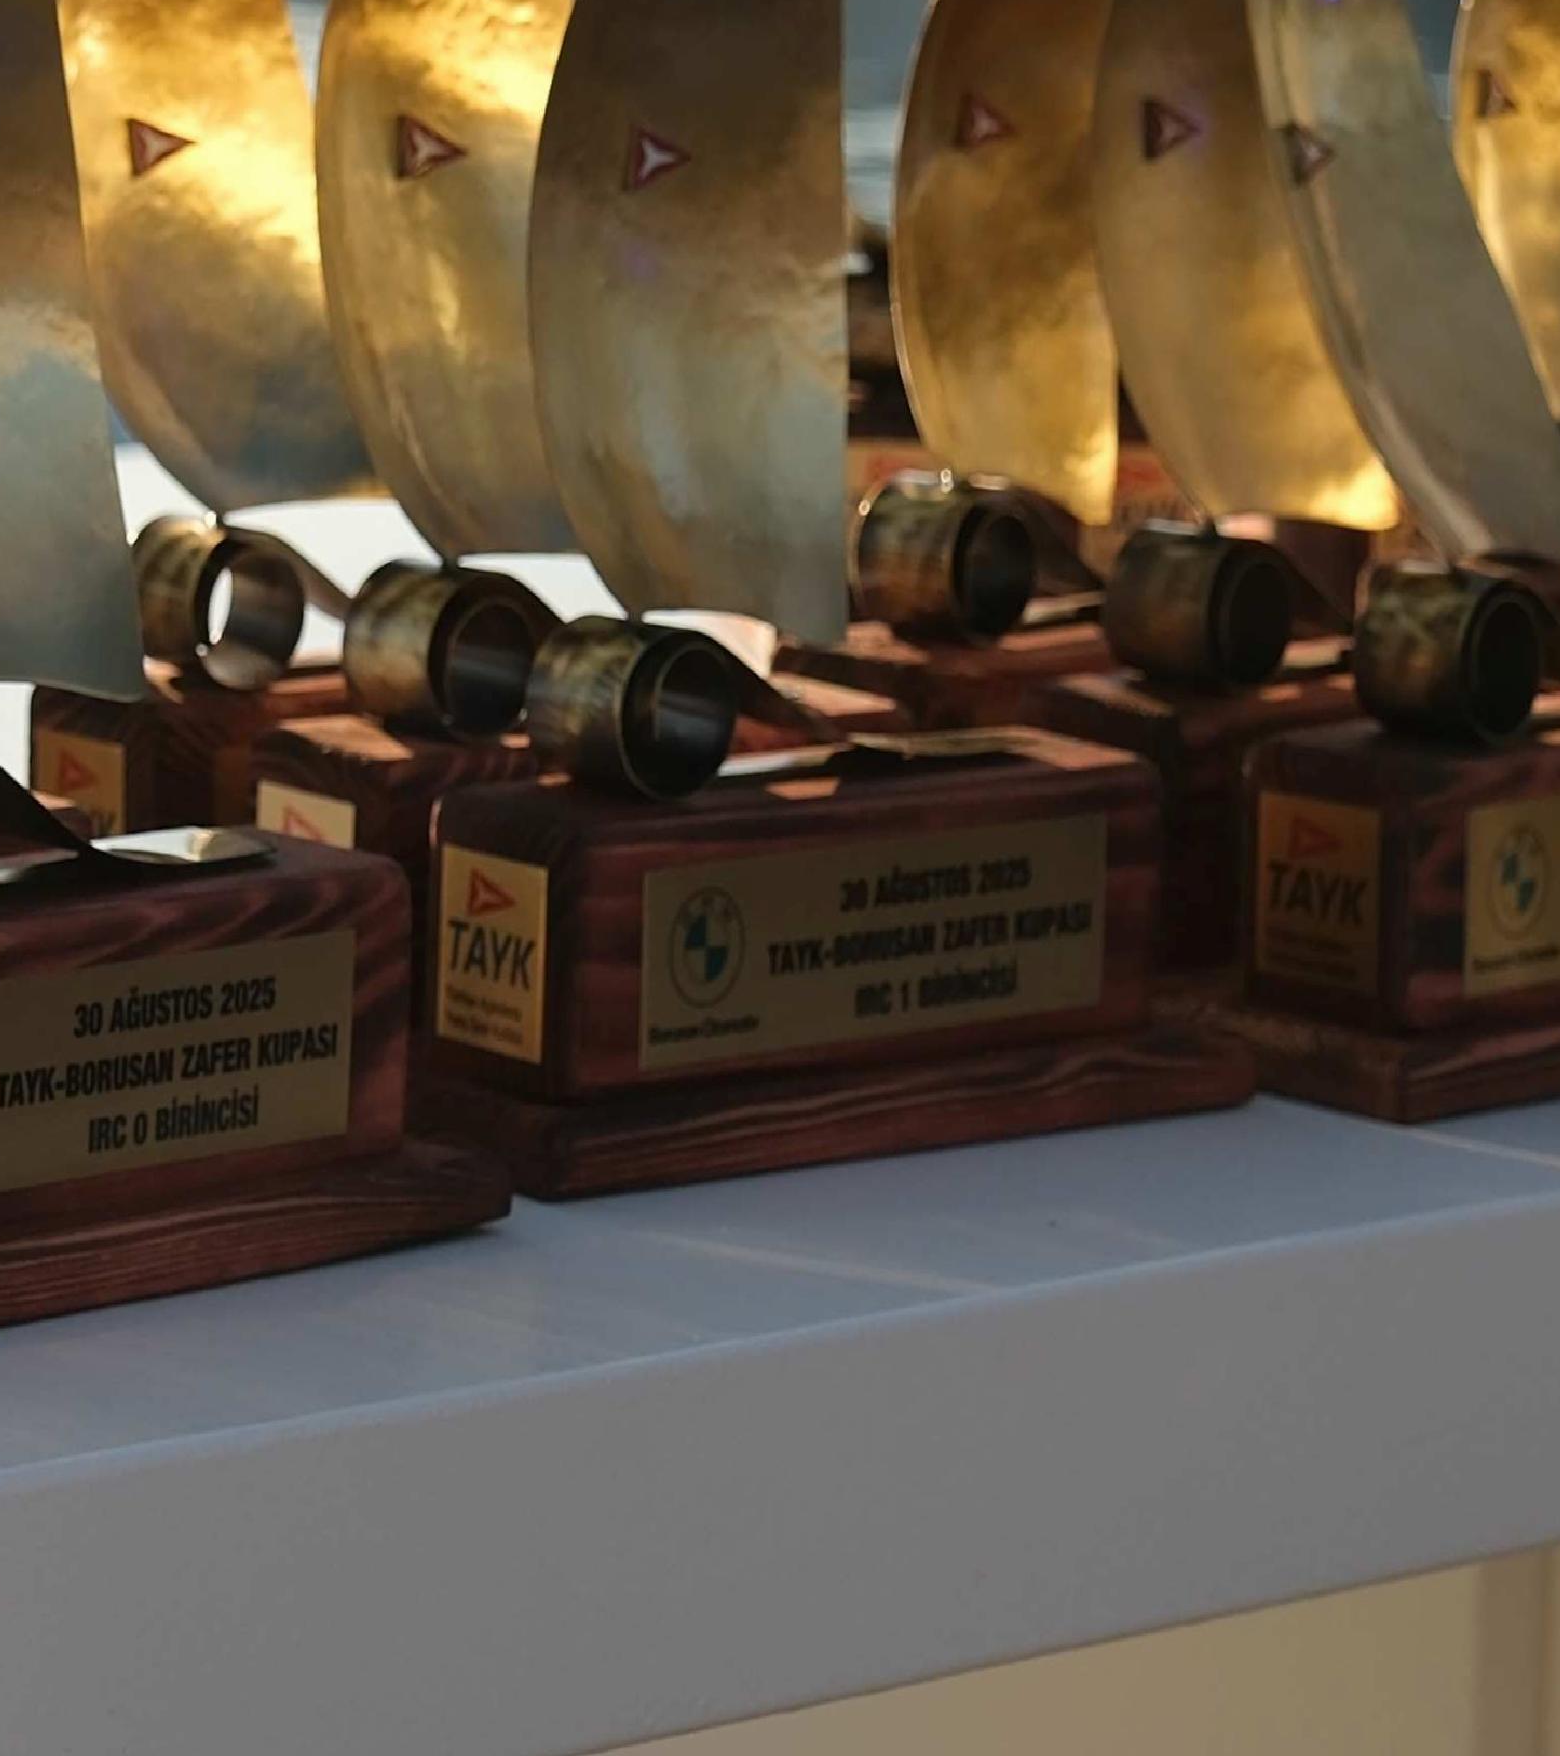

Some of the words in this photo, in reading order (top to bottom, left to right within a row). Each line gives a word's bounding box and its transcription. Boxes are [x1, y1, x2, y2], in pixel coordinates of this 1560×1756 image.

[839, 877, 869, 913] 30
[1267, 860, 1369, 928] TAYK
[448, 919, 537, 992] TAYK
[943, 912, 1009, 951] ZAFER
[74, 1002, 104, 1040] 30
[109, 984, 214, 1034] AĞUSTOS
[220, 975, 277, 1017] 2025
[899, 979, 911, 1013] 1
[181, 1037, 251, 1081] ZAFER
[257, 1022, 339, 1068] KUPASI
[88, 1113, 128, 1154] IRC
[155, 1084, 260, 1142] BİRİNCİSİ
